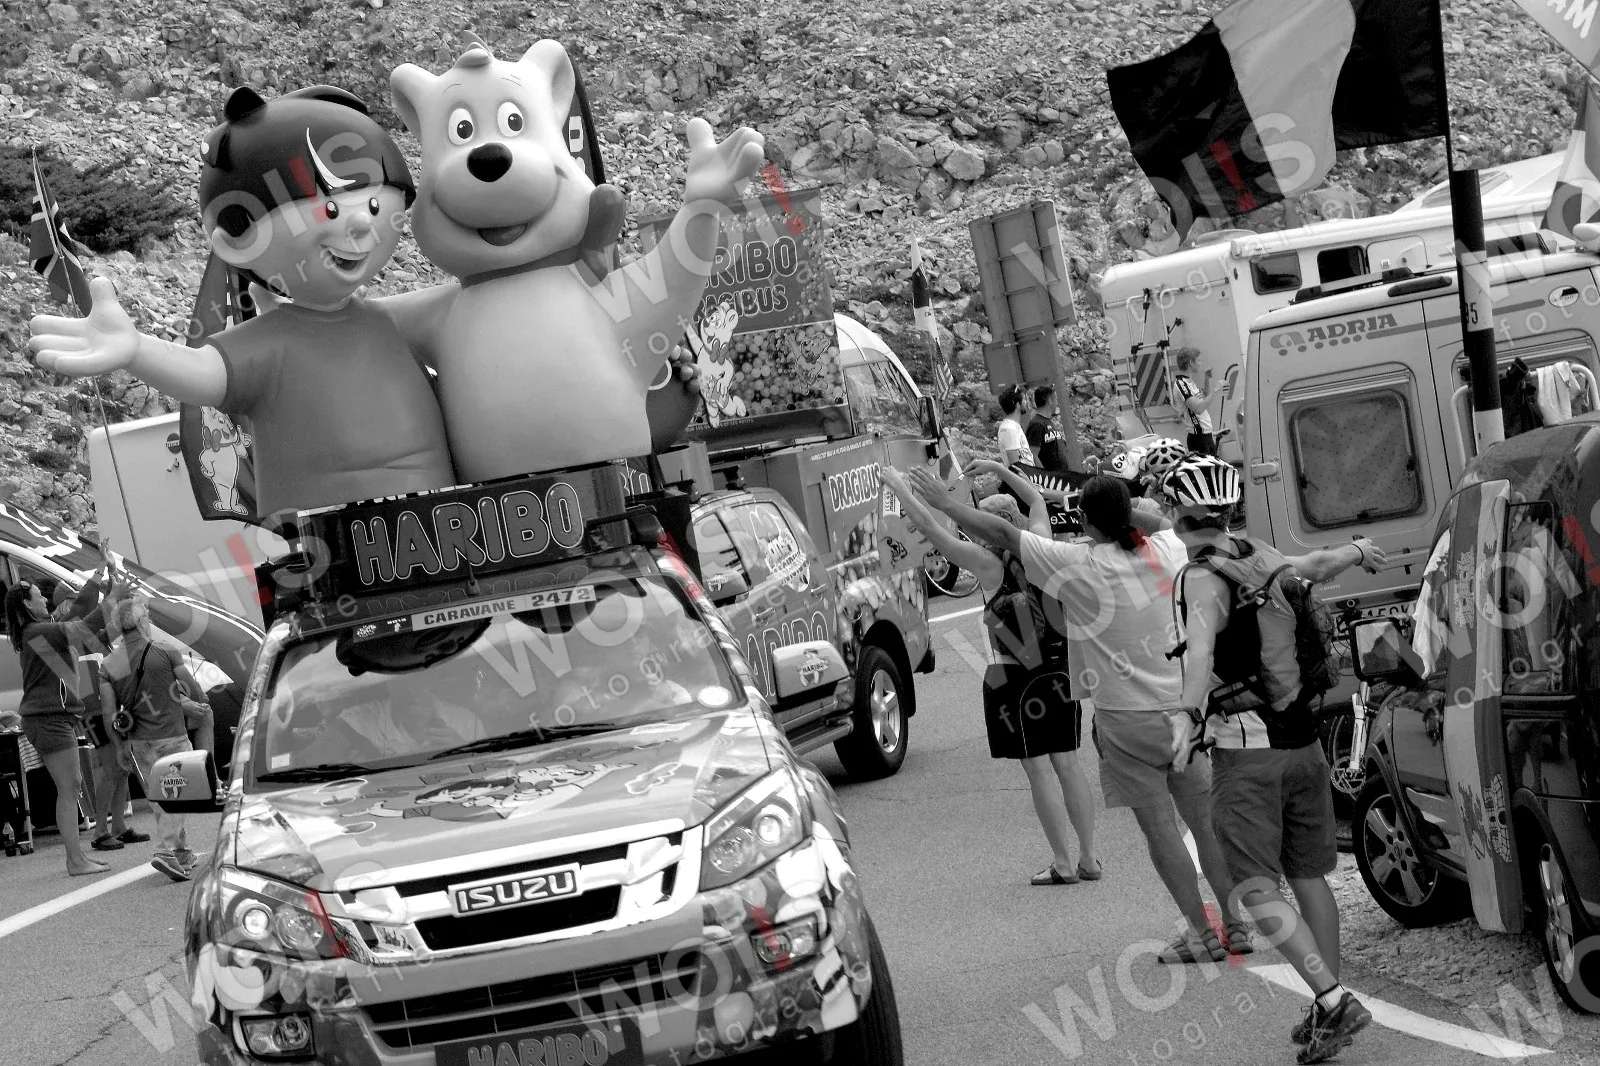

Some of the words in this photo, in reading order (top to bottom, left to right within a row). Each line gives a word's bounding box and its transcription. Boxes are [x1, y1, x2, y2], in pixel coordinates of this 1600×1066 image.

[704, 235, 798, 288] RIBO
[1307, 313, 1398, 342] ADRIA
[828, 461, 881, 513] DRAGIBUS
[350, 481, 585, 586] HARIBO
[423, 599, 517, 626] CARAVANE
[531, 587, 591, 607] 2472
[458, 871, 574, 911] ISUZU
[467, 1028, 609, 1066] HARIBO
